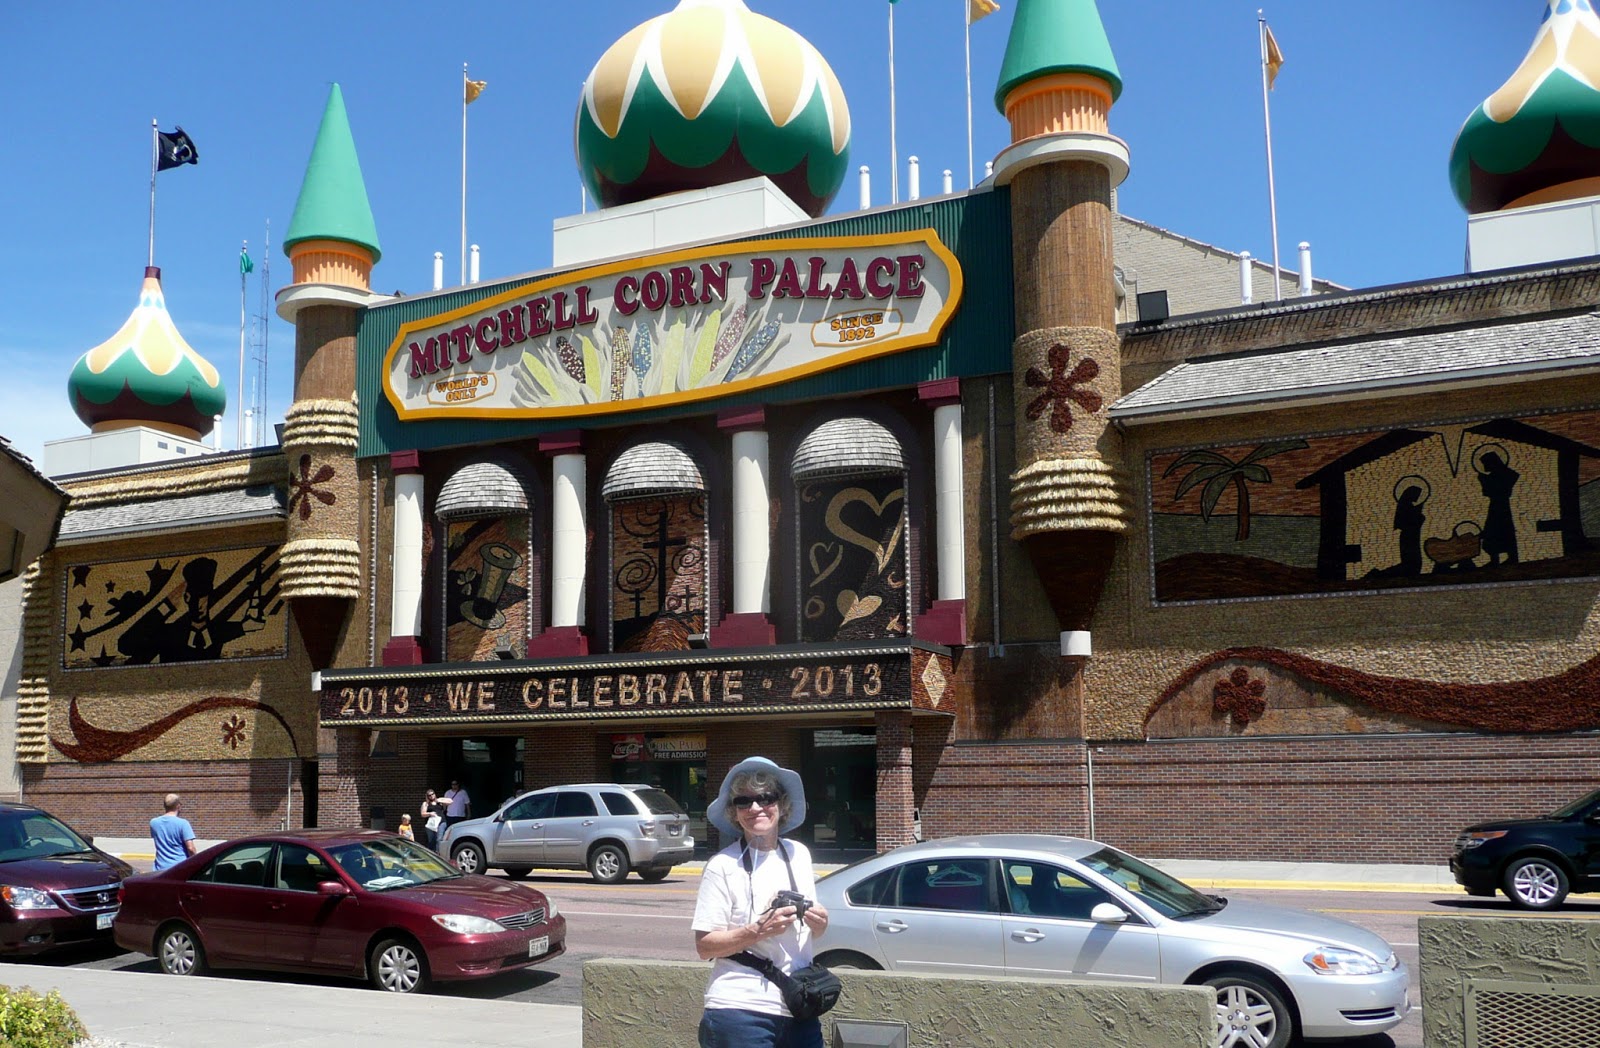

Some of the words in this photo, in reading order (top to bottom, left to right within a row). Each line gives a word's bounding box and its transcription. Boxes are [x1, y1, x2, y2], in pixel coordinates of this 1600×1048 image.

[408, 285, 598, 379] MITCHELL
[614, 261, 731, 316] CORN
[748, 254, 925, 299] PALACE
[830, 312, 884, 332] SINCE
[838, 326, 876, 343] 1892
[435, 374, 489, 393] WORLD'S
[445, 387, 478, 402] ONLY
[340, 685, 410, 716] 2013
[446, 680, 495, 711] WE
[522, 669, 744, 709] CELEBRATE
[790, 662, 882, 698] 2013
